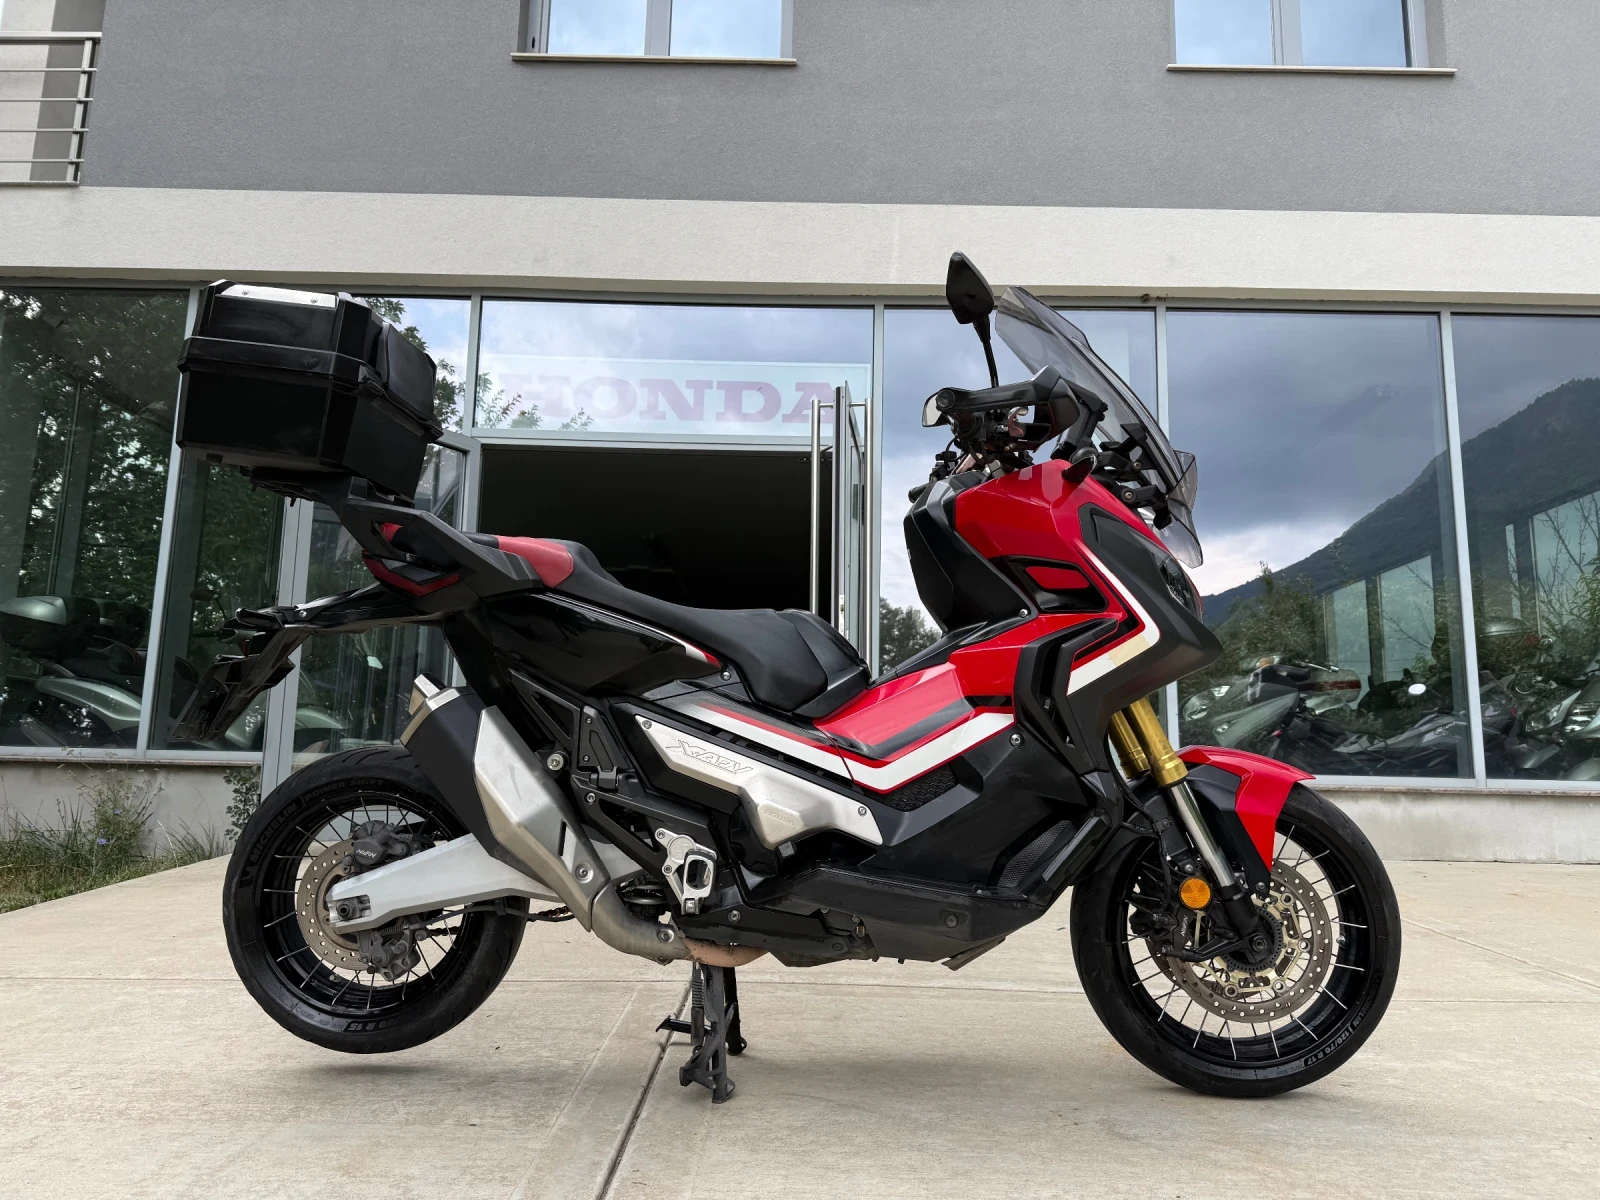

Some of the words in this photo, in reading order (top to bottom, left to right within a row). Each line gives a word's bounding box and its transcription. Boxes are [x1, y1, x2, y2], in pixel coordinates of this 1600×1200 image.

[496, 373, 837, 424] HONDA
[249, 801, 298, 863] MICHELIN
[304, 781, 346, 802] POWER
[764, 811, 795, 826] HONDA
[348, 1022, 363, 1031] 15
[365, 1022, 377, 1031] R
[1324, 1029, 1350, 1055] 120/70
[1307, 1055, 1317, 1065] 17
[1317, 1051, 1325, 1059] R
